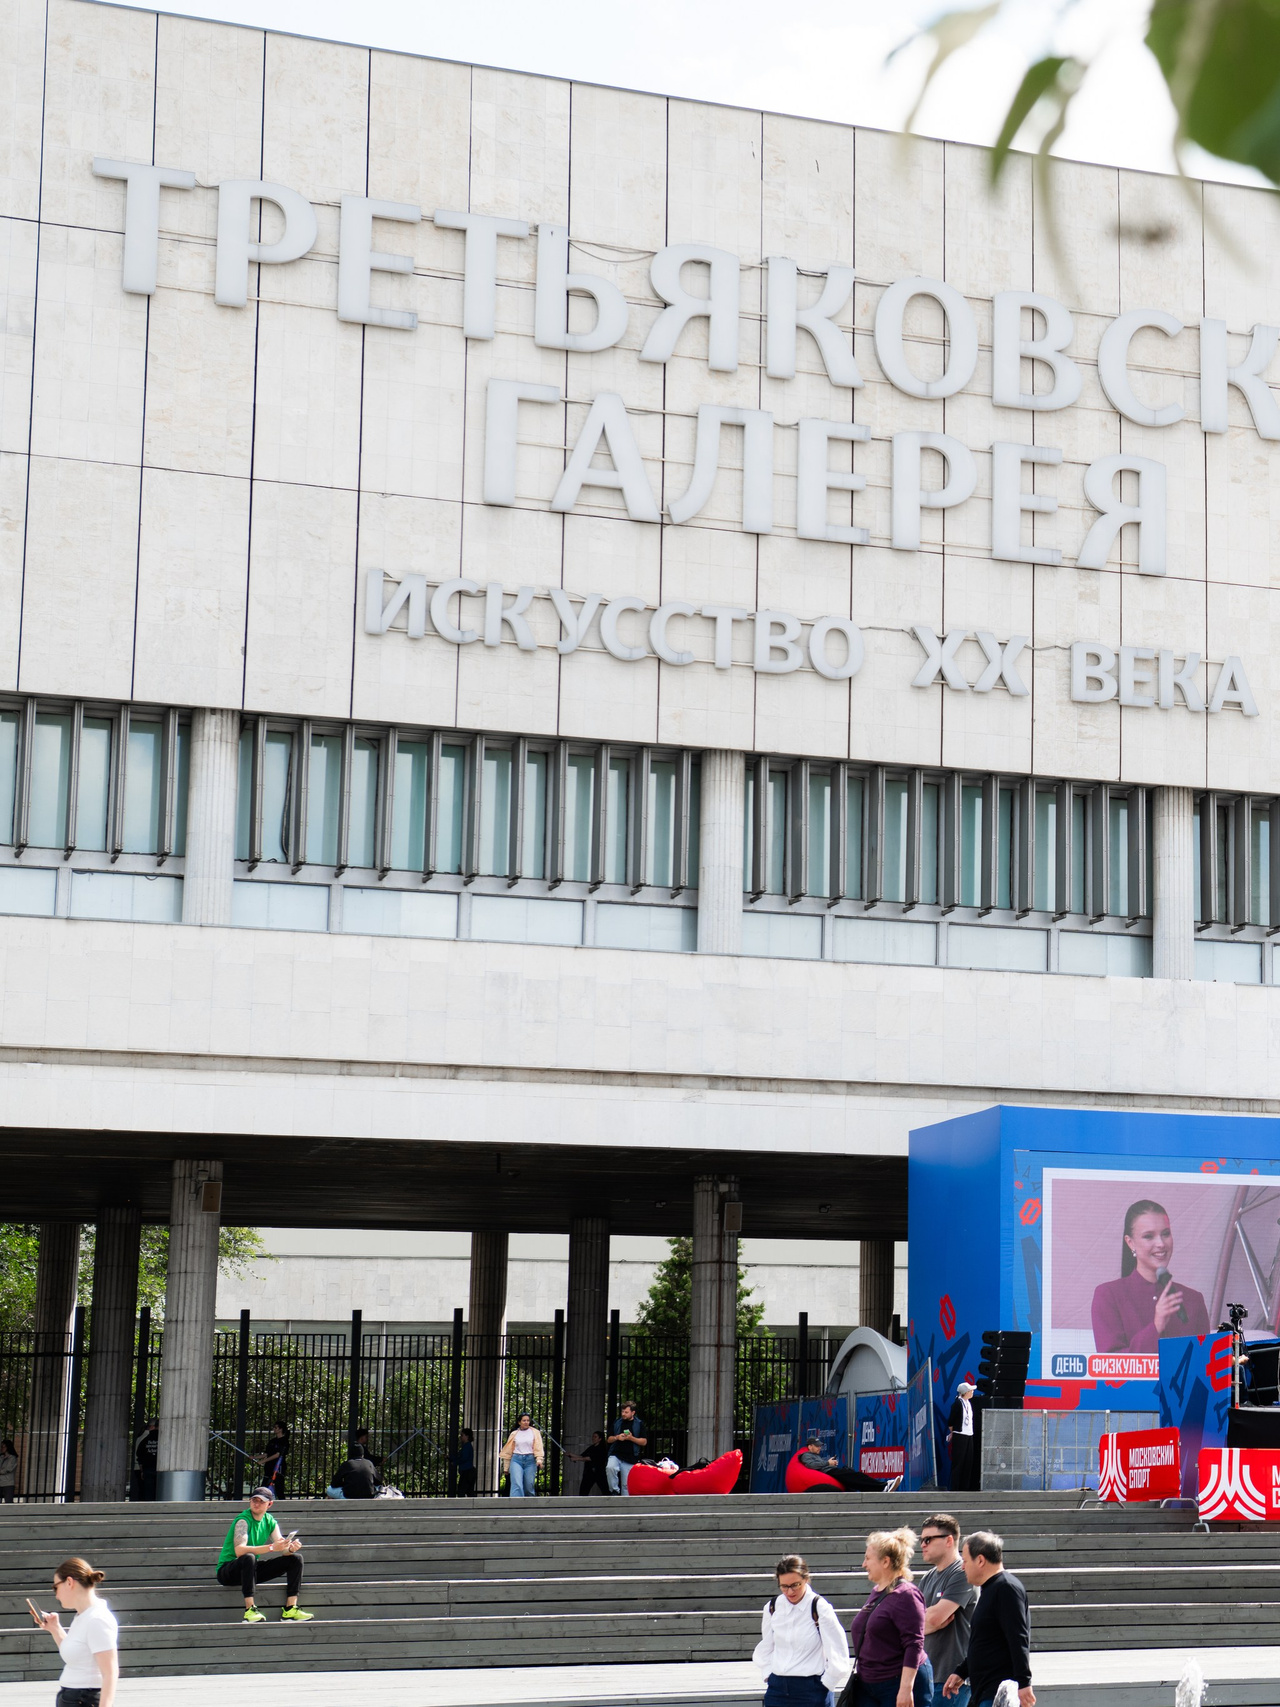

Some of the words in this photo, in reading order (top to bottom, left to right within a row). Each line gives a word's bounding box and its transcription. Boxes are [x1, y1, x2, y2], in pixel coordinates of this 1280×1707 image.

[482, 378, 1167, 576] ГАЛЕРЕЯ
[364, 568, 864, 681] ИСКУССТВО
[1070, 640, 1260, 717] ВЕКА
[1055, 1357, 1083, 1374] ДЕНЬ
[1129, 1440, 1174, 1468] МОСКОВСКИЙ
[1129, 1468, 1151, 1489] СПОРТ
